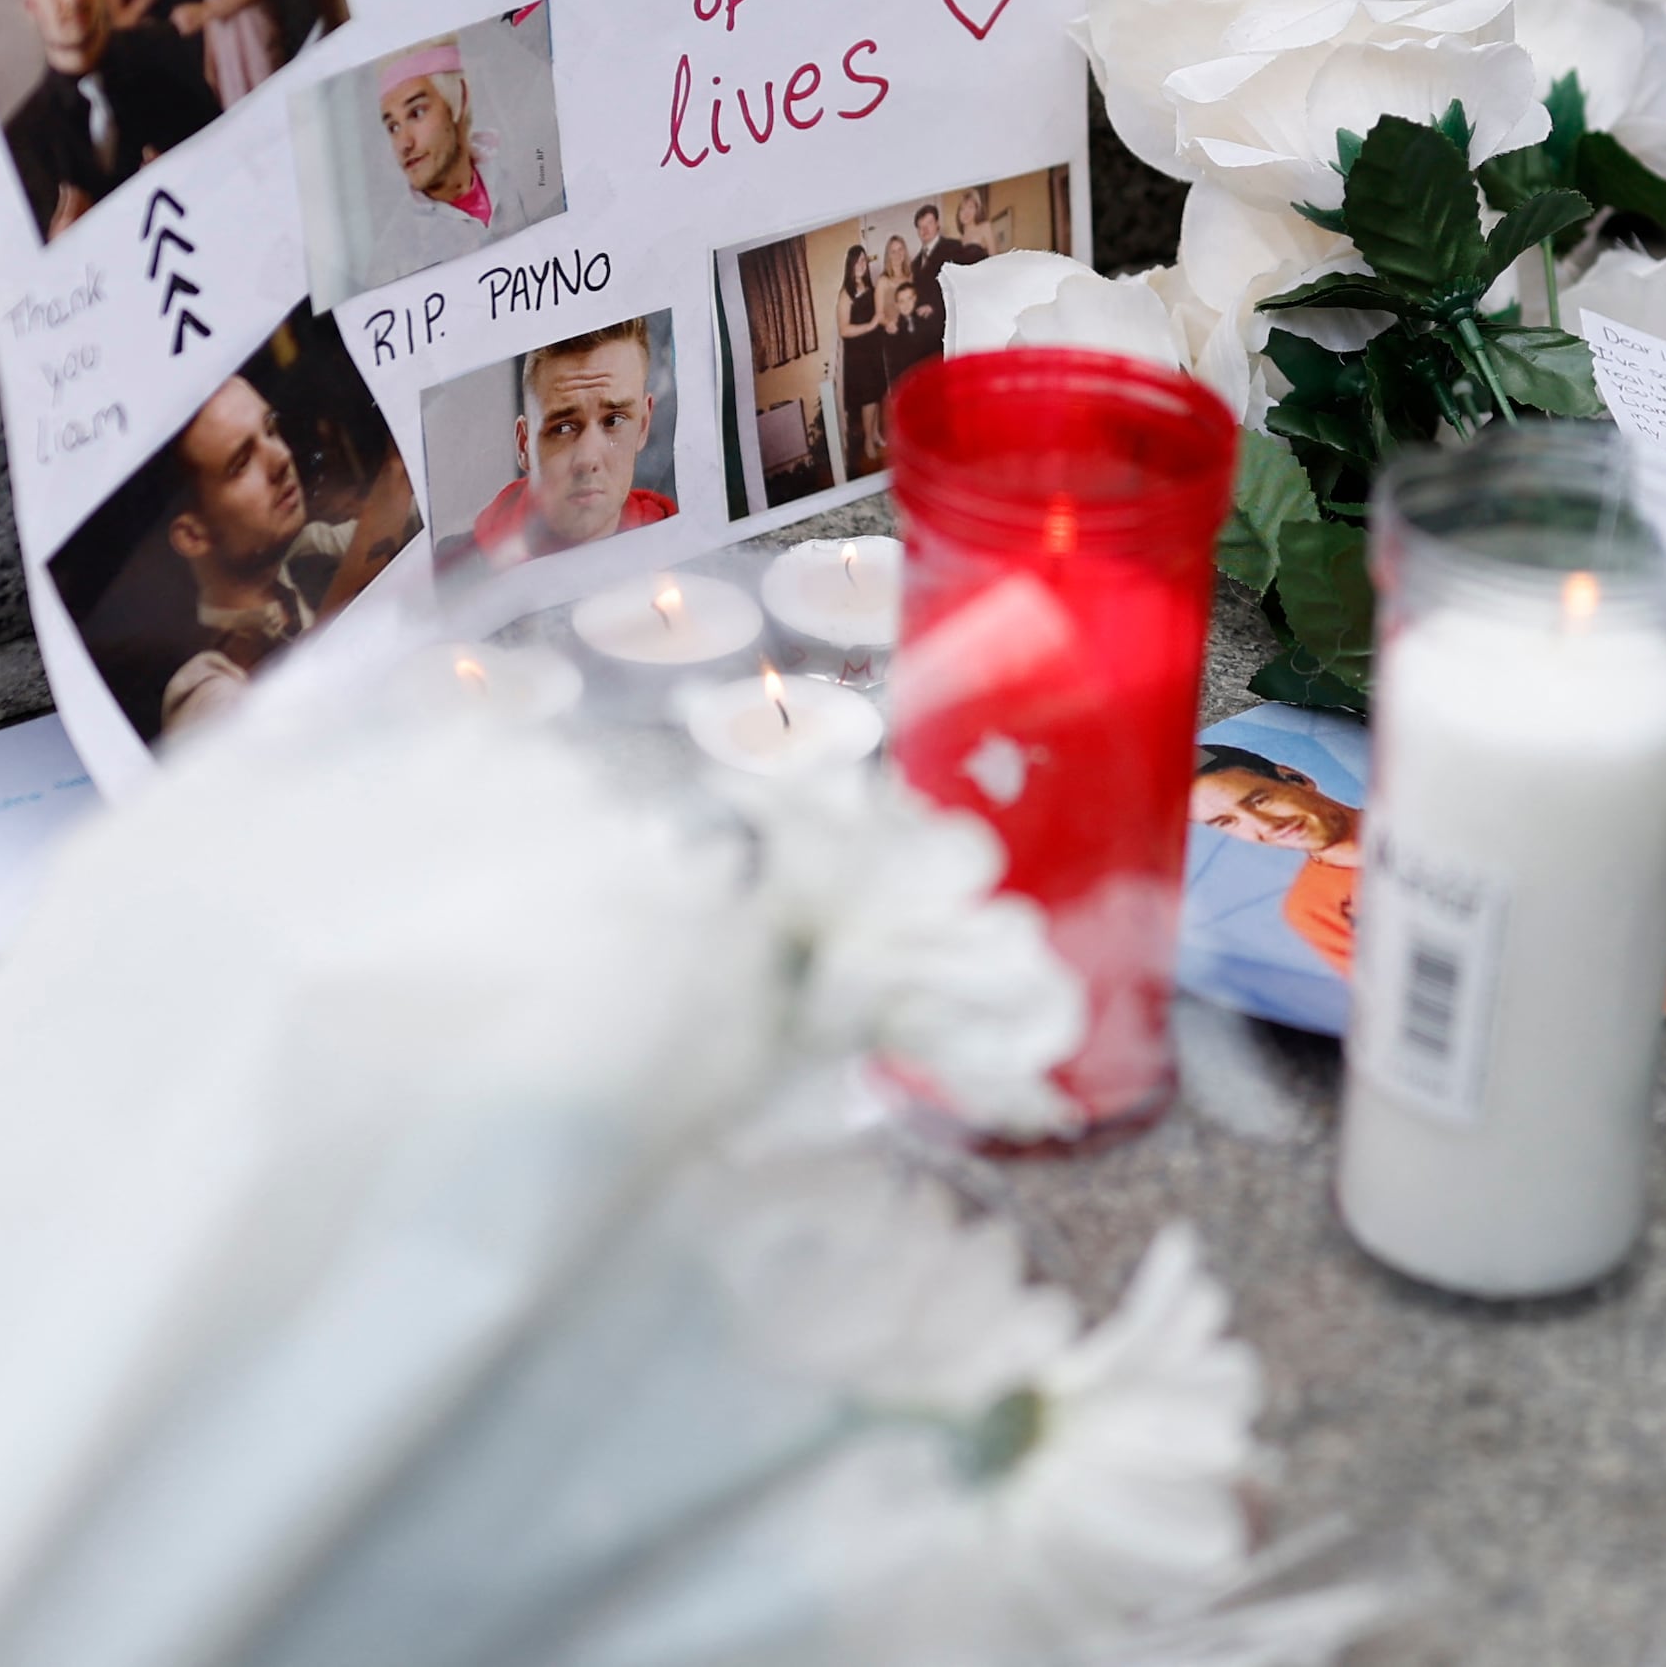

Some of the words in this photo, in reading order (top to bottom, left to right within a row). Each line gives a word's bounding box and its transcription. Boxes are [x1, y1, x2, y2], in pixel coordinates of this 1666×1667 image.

[660, 39, 889, 169] lives
[1, 261, 103, 340] Thank
[478, 249, 612, 321] PAYNO
[1595, 345, 1640, 372] I've
[1603, 326, 1651, 354] Dear
[39, 342, 101, 409] you
